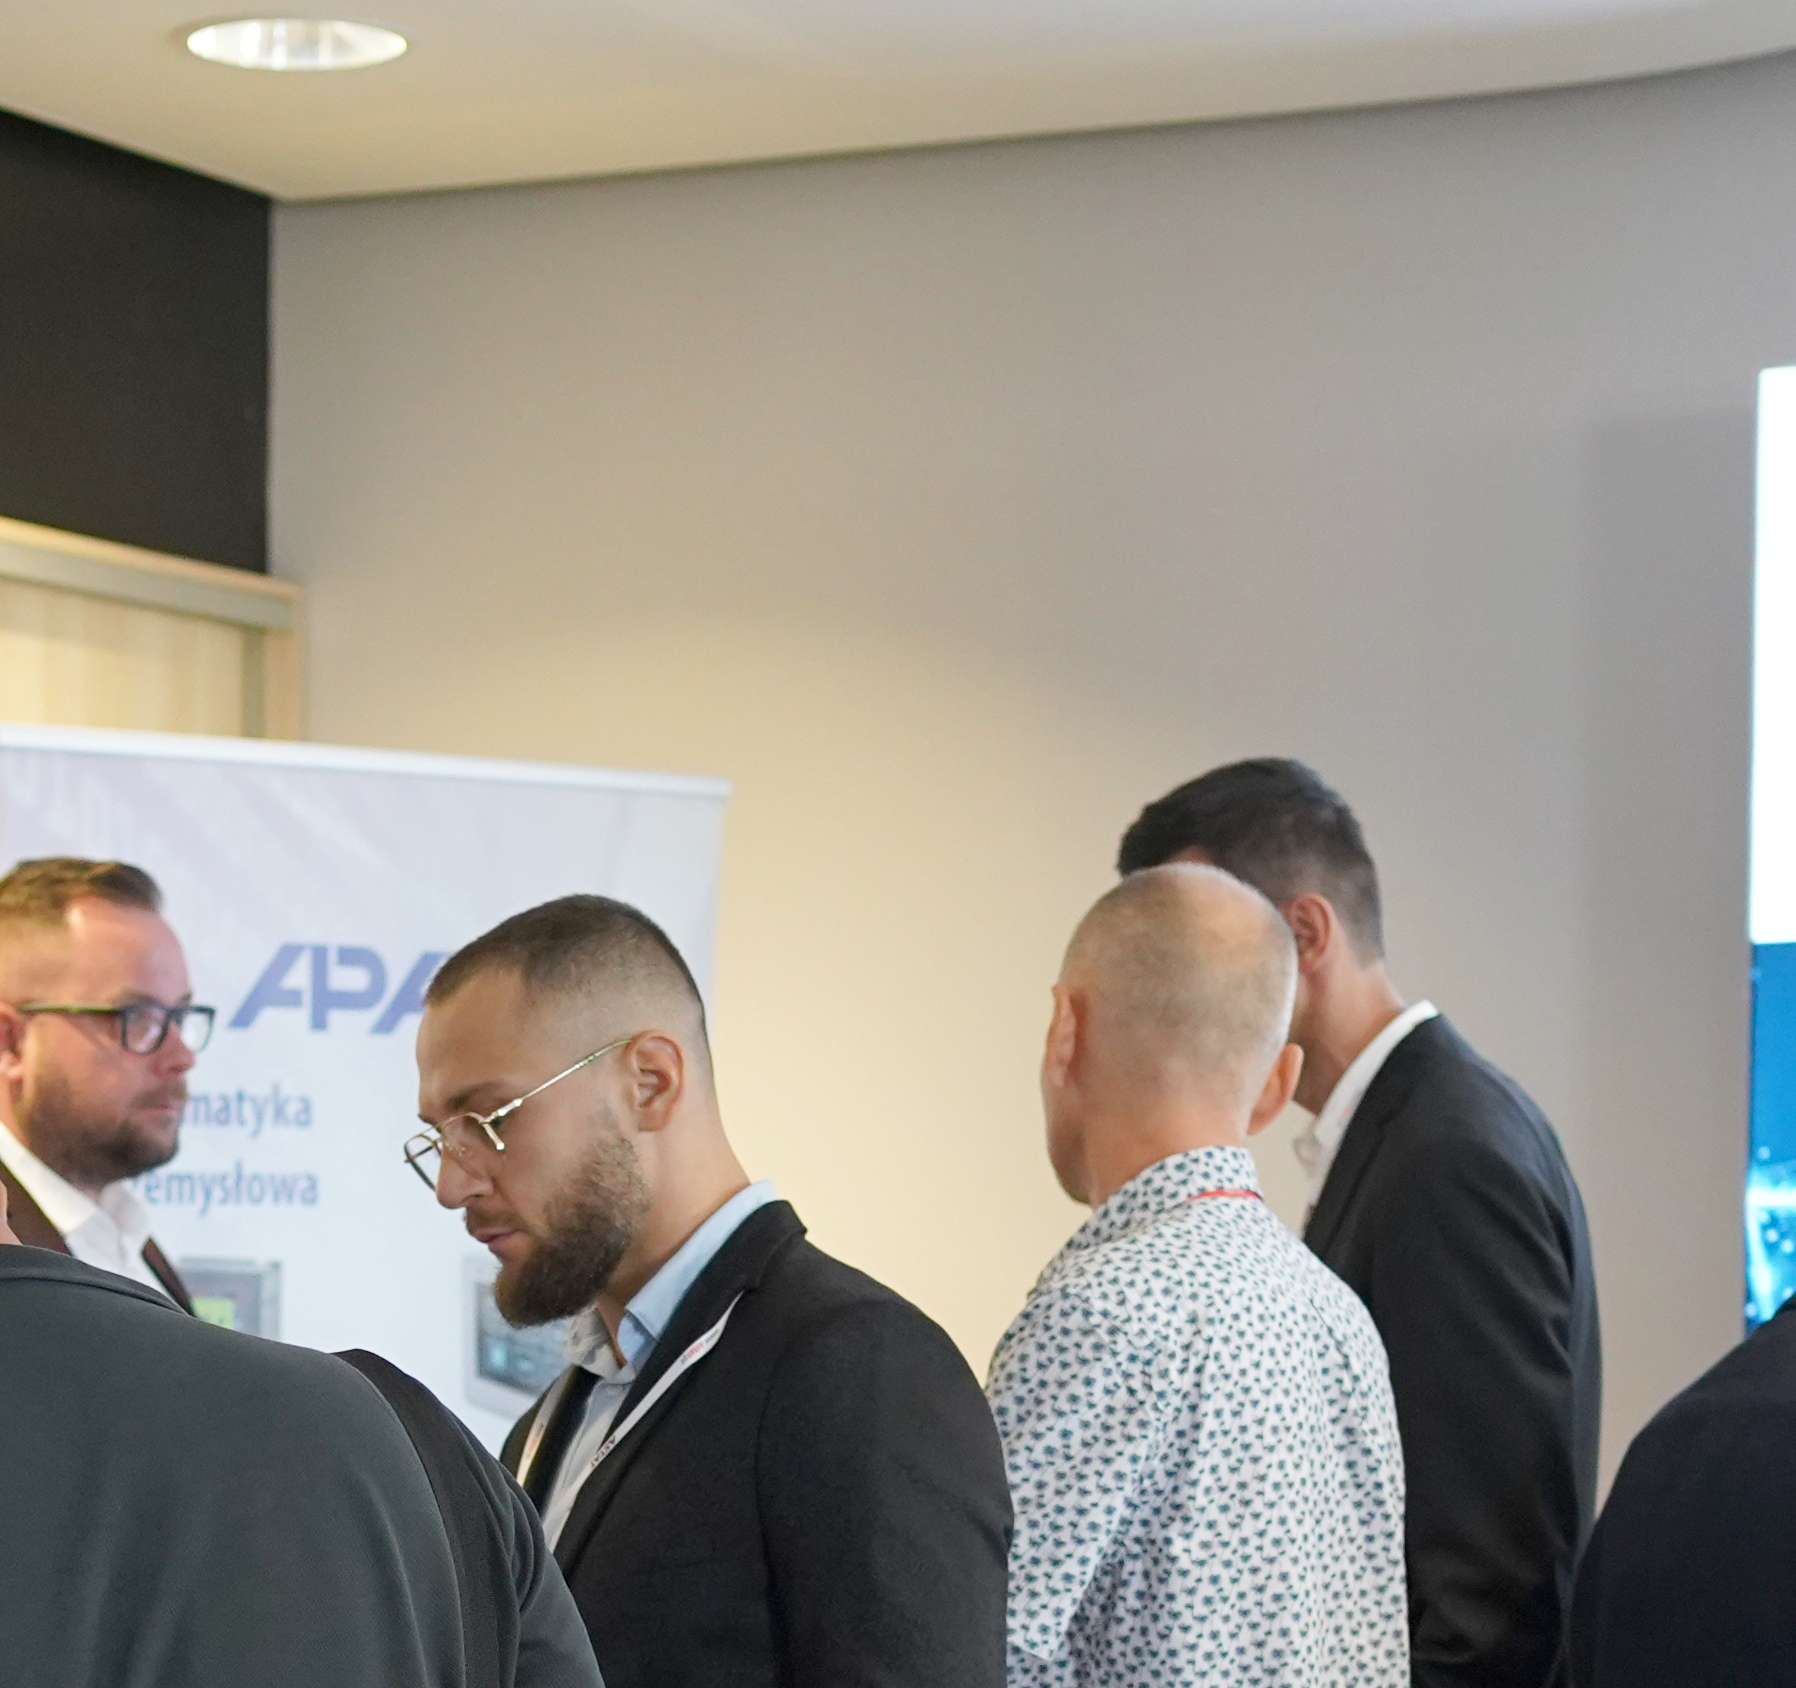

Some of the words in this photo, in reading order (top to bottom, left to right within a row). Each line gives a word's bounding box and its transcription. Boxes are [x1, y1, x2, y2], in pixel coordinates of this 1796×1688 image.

[227, 943, 453, 1034] APA
[190, 1083, 313, 1137] matyka
[131, 1160, 319, 1216] emysłowa
